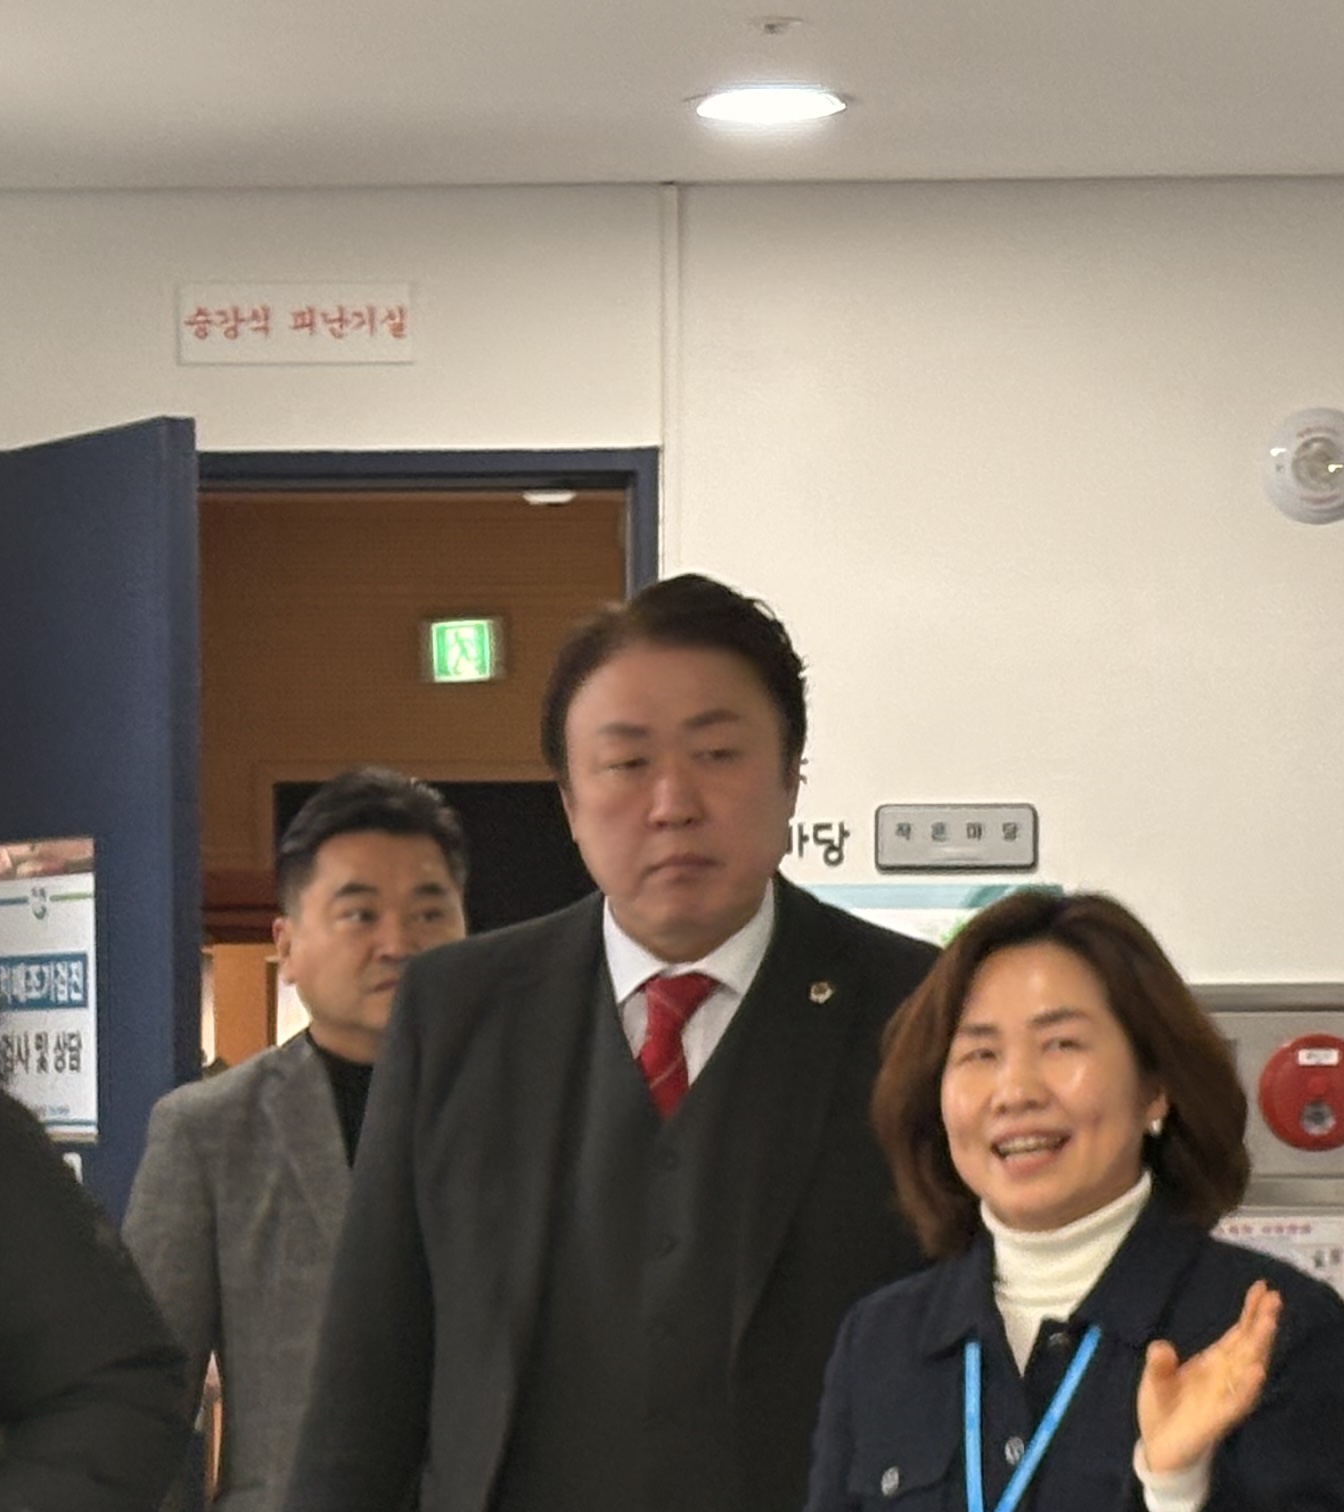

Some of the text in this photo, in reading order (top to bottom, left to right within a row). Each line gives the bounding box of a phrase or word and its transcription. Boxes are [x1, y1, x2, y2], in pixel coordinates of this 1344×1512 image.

[184, 304, 407, 341] 승강식 피난기실
[35, 1030, 49, 1074] 및
[53, 1029, 83, 1073] 상담
